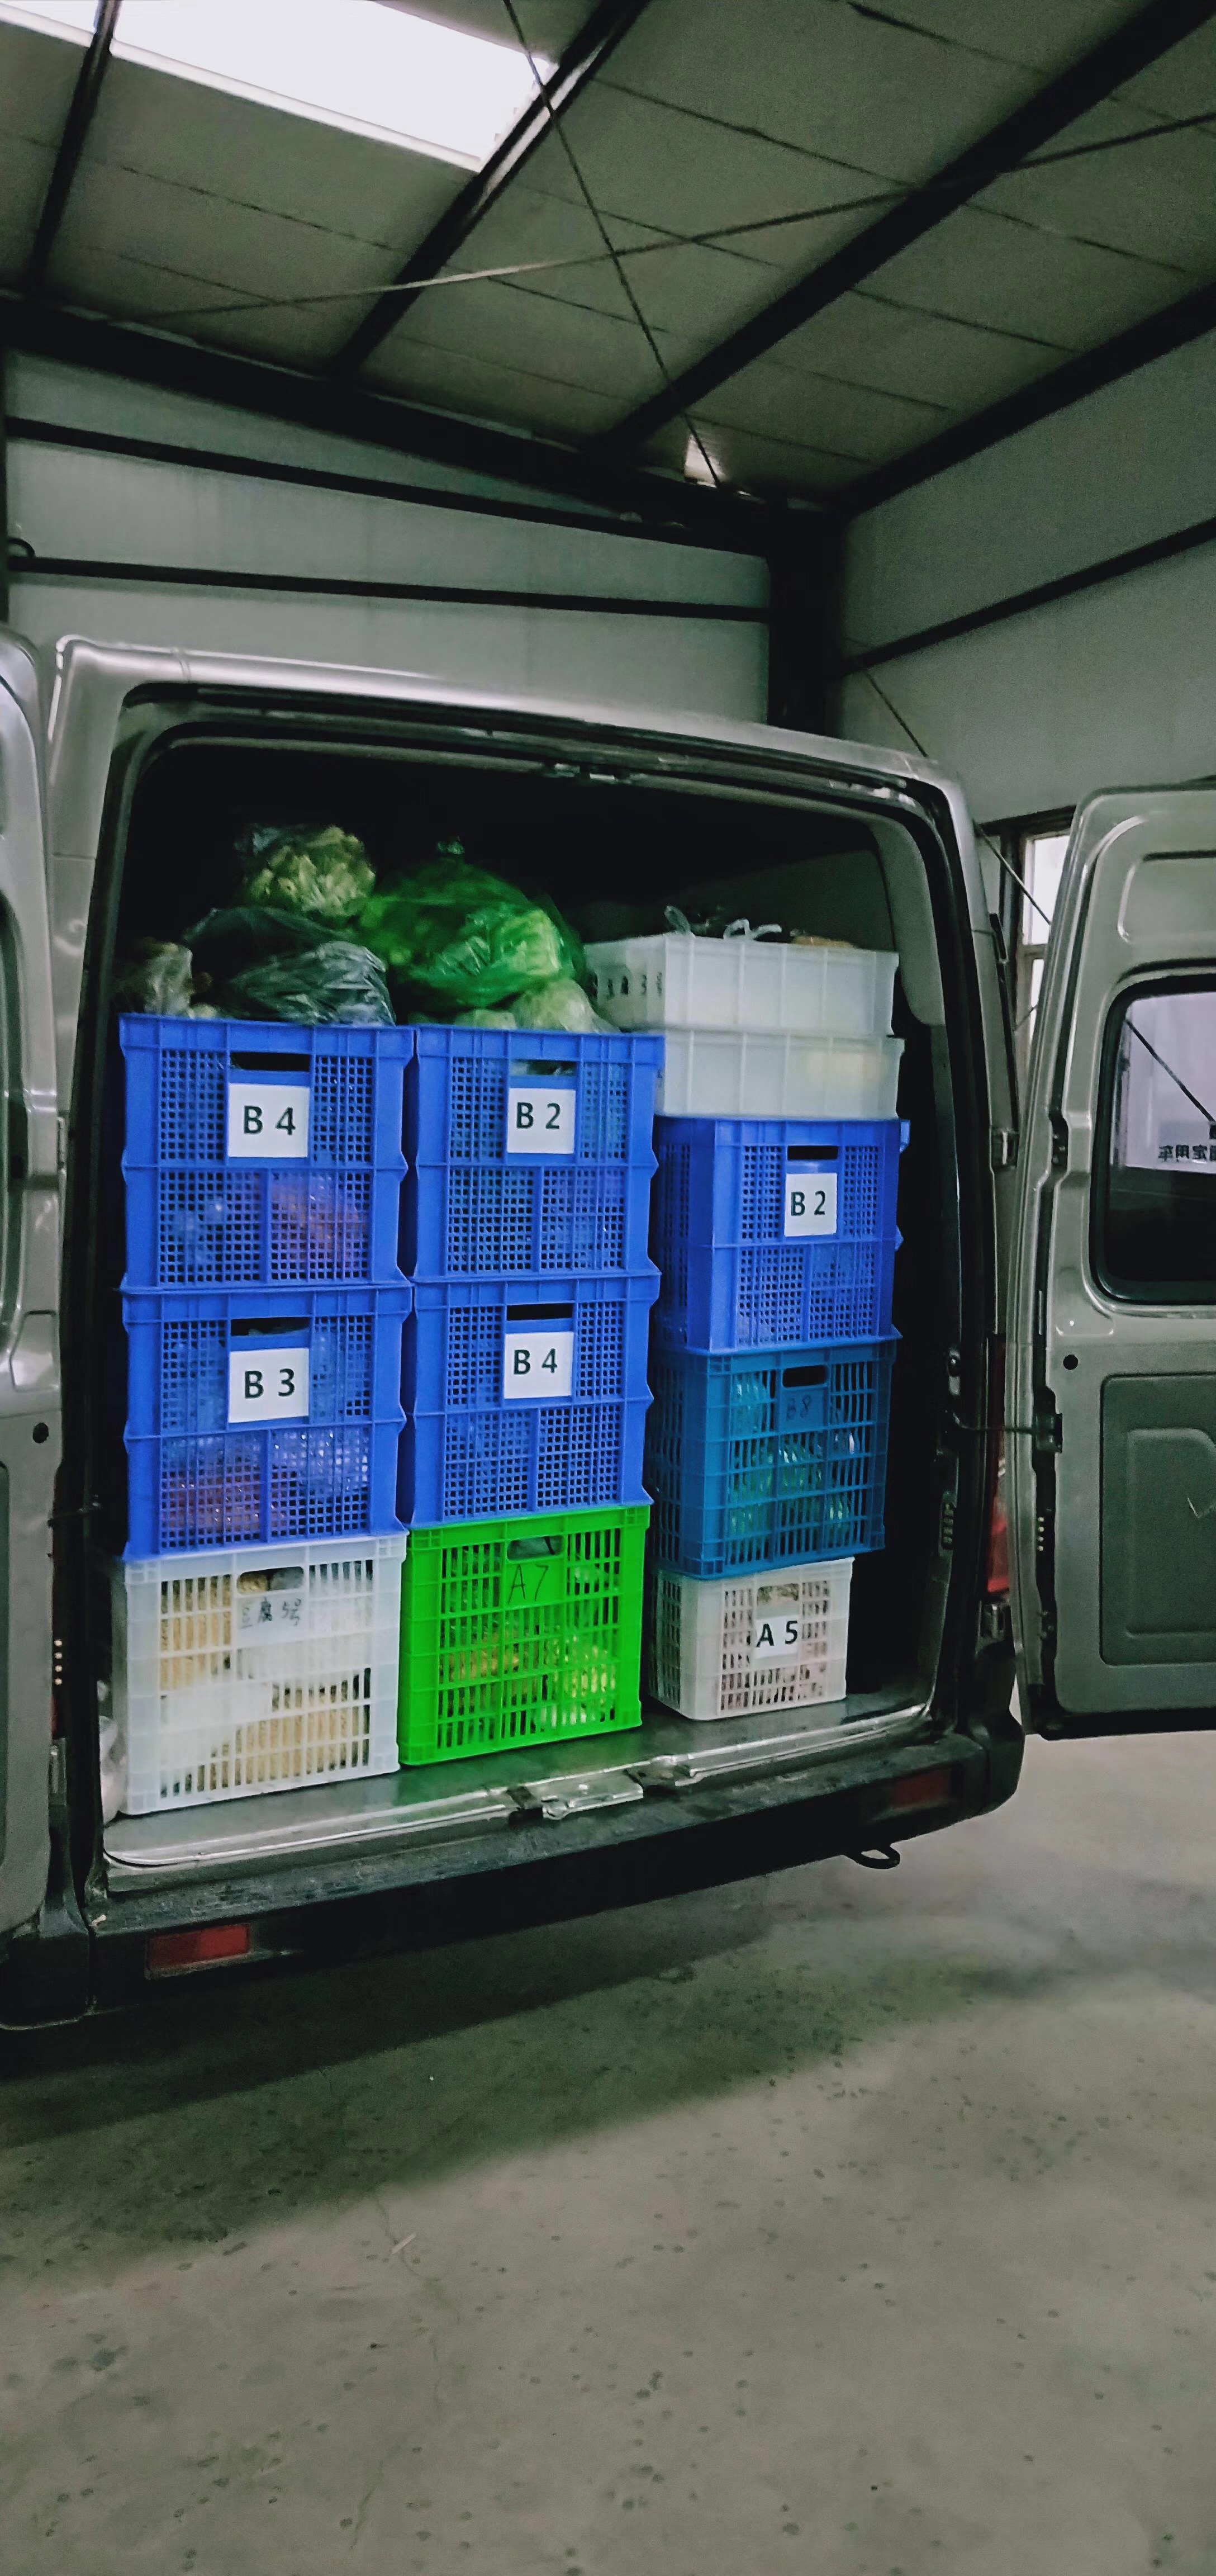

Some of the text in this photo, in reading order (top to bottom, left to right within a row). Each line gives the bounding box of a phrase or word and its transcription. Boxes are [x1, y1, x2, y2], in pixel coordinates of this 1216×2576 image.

[243, 1105, 296, 1135] B 4
[516, 1102, 561, 1129] B 2
[791, 1190, 826, 1216] B 2
[514, 1348, 558, 1375] B 4
[244, 1368, 295, 1399] B 3
[507, 1564, 549, 1605] A7
[756, 1620, 798, 1647] A 5
